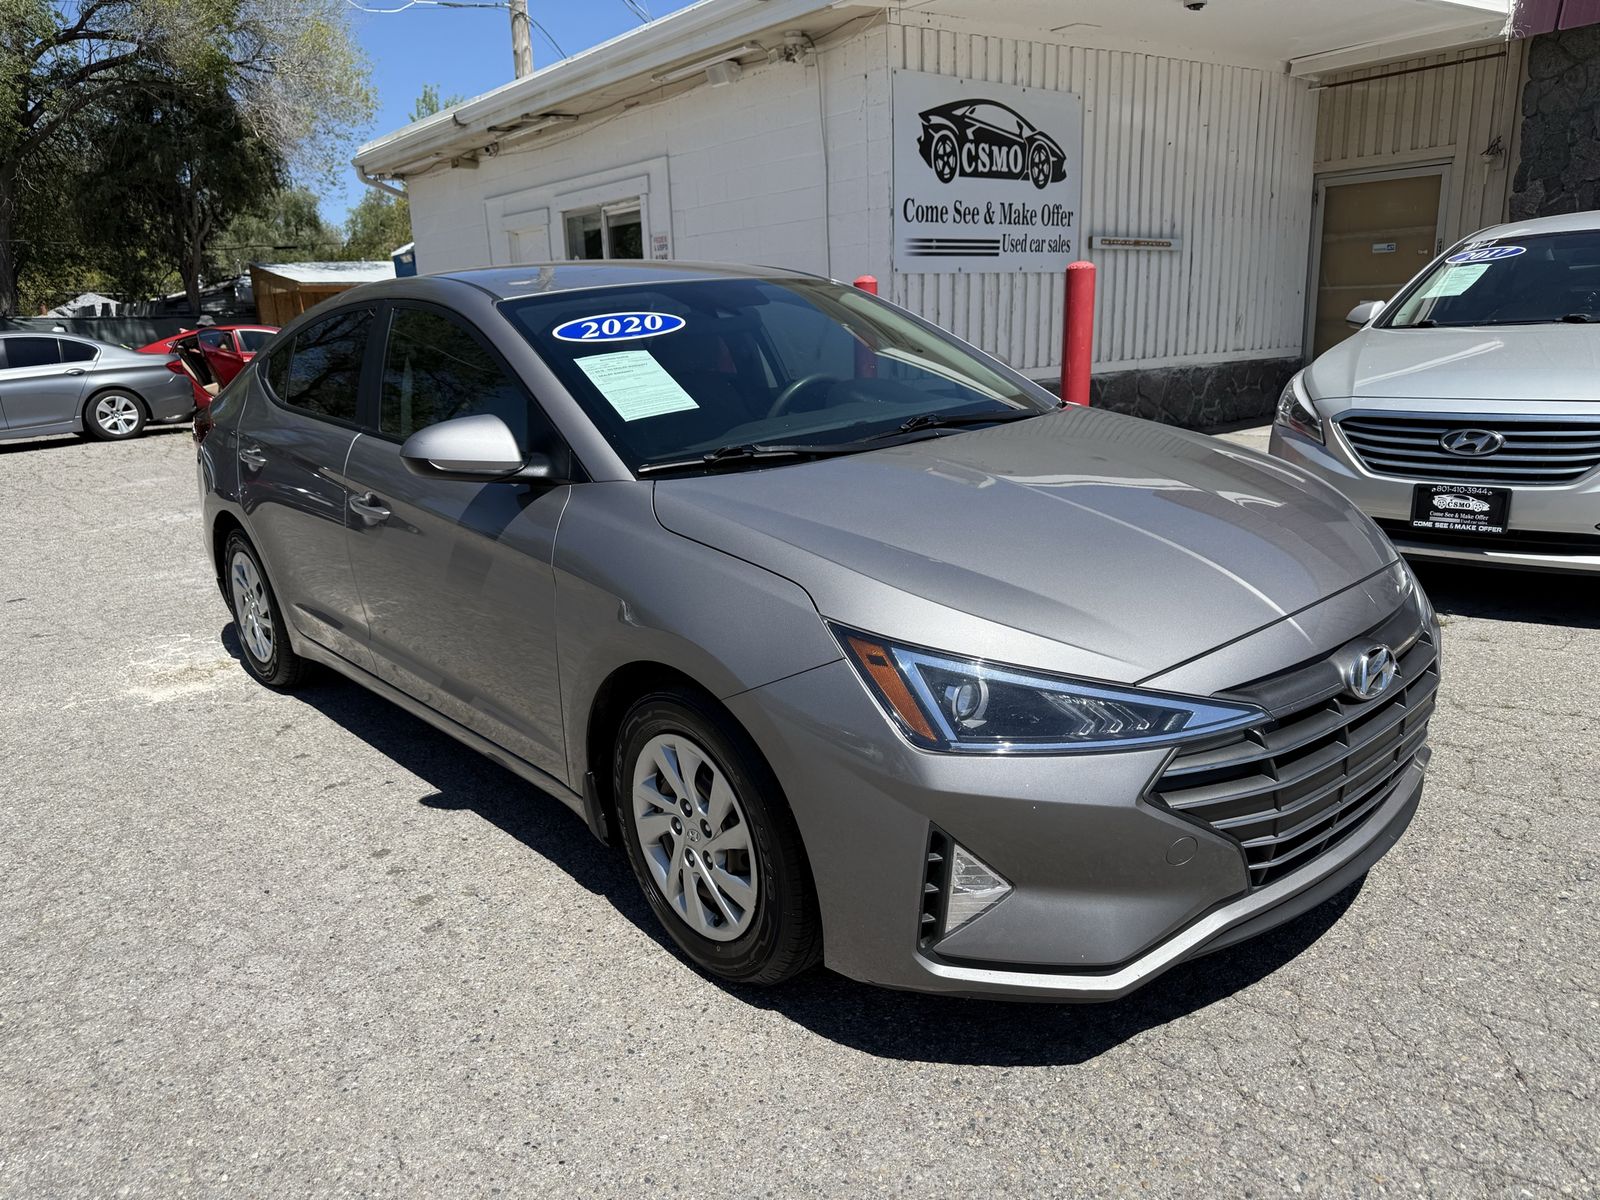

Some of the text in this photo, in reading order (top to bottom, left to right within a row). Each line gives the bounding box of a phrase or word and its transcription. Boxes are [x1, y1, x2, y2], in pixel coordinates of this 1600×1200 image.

[962, 141, 1023, 173] CSMO
[903, 198, 1074, 228] Come See & Make Offer
[1002, 234, 1071, 254] Used car sales
[581, 314, 663, 338] 2020
[1436, 486, 1487, 494] 801-410-3944
[1478, 525, 1502, 533] OFFER
